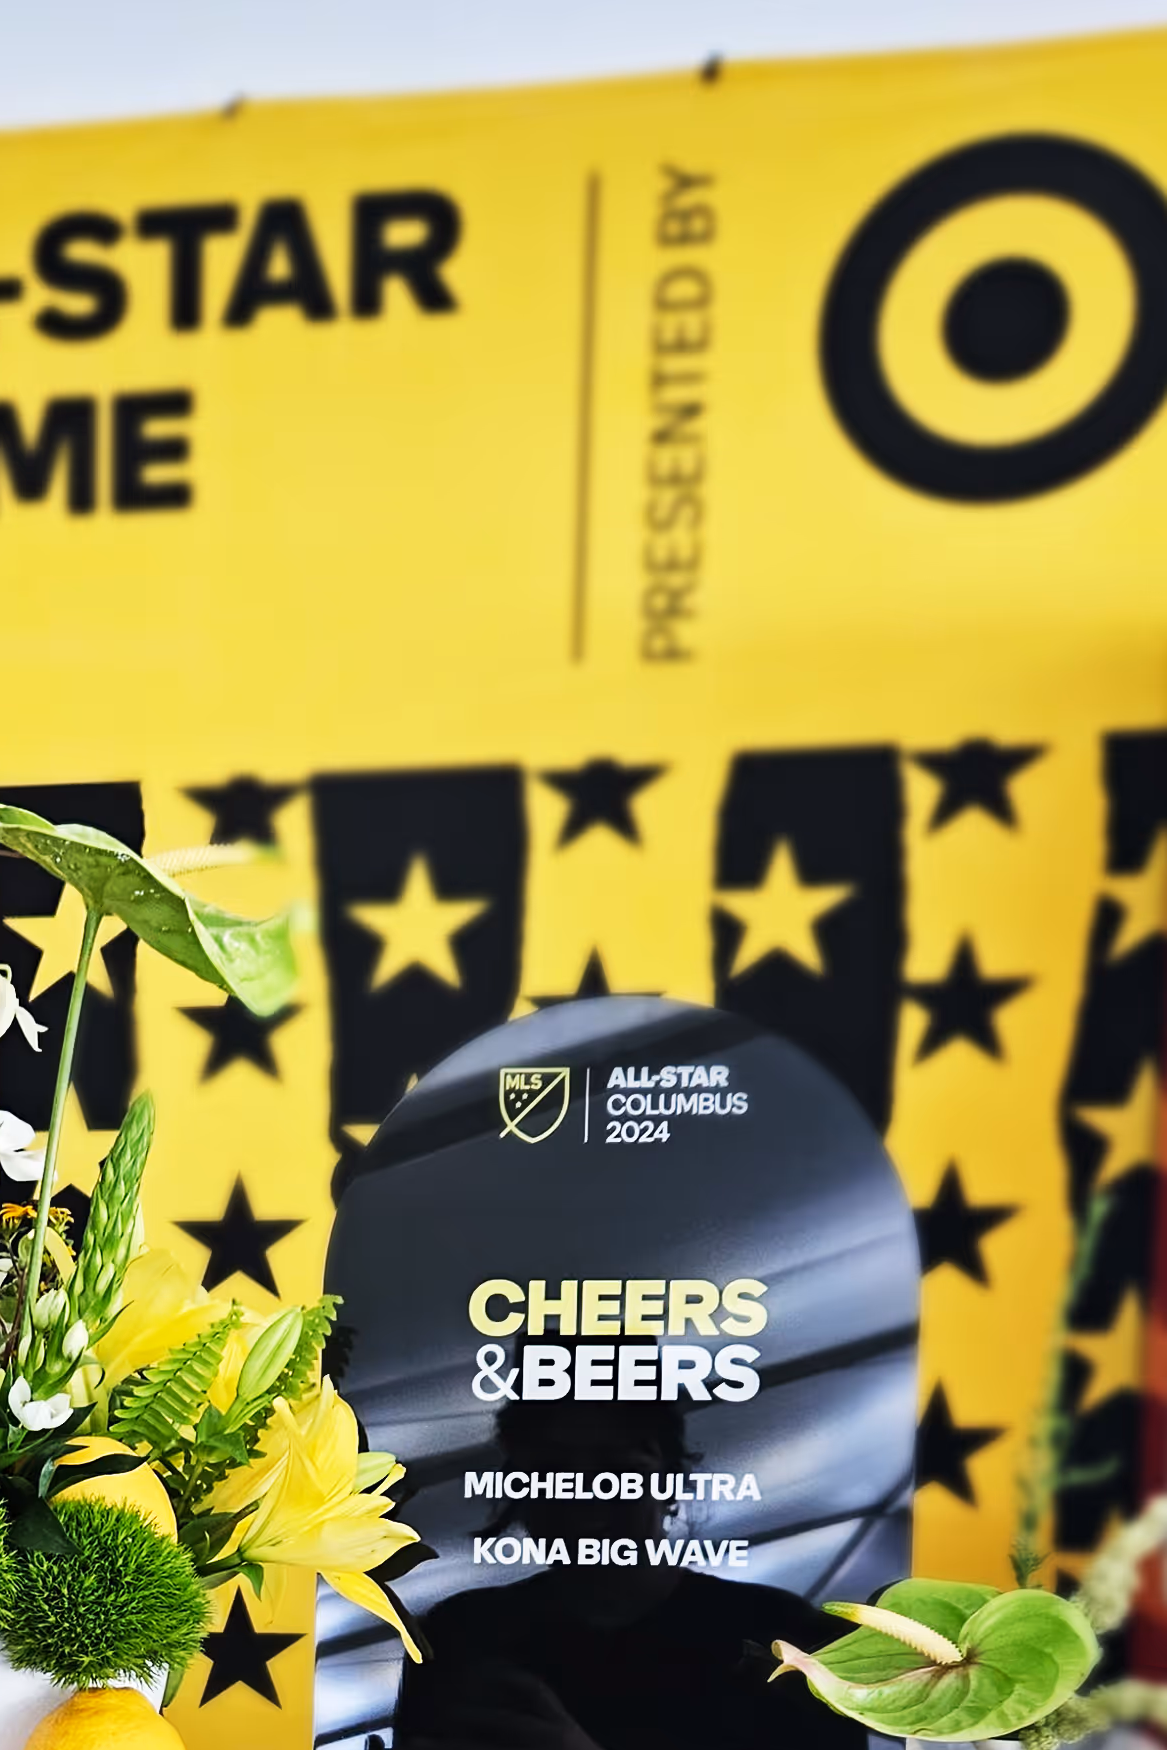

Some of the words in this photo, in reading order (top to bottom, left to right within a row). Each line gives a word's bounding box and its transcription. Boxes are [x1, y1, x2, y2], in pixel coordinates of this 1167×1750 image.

[654, 161, 718, 249] BY
[639, 263, 715, 666] PRESENTED
[505, 1074, 543, 1090] MLS
[606, 1065, 730, 1089] ALL-STAR
[606, 1091, 749, 1117] COLUMBUS
[605, 1120, 671, 1144] 2024
[468, 1278, 769, 1337] CHEERS
[471, 1343, 761, 1402] &BEERS
[464, 1471, 644, 1500] MICHELOB
[650, 1472, 762, 1501] ULTRA
[473, 1536, 571, 1565] KONA
[577, 1538, 638, 1566] BIG
[644, 1538, 750, 1567] WAVE
